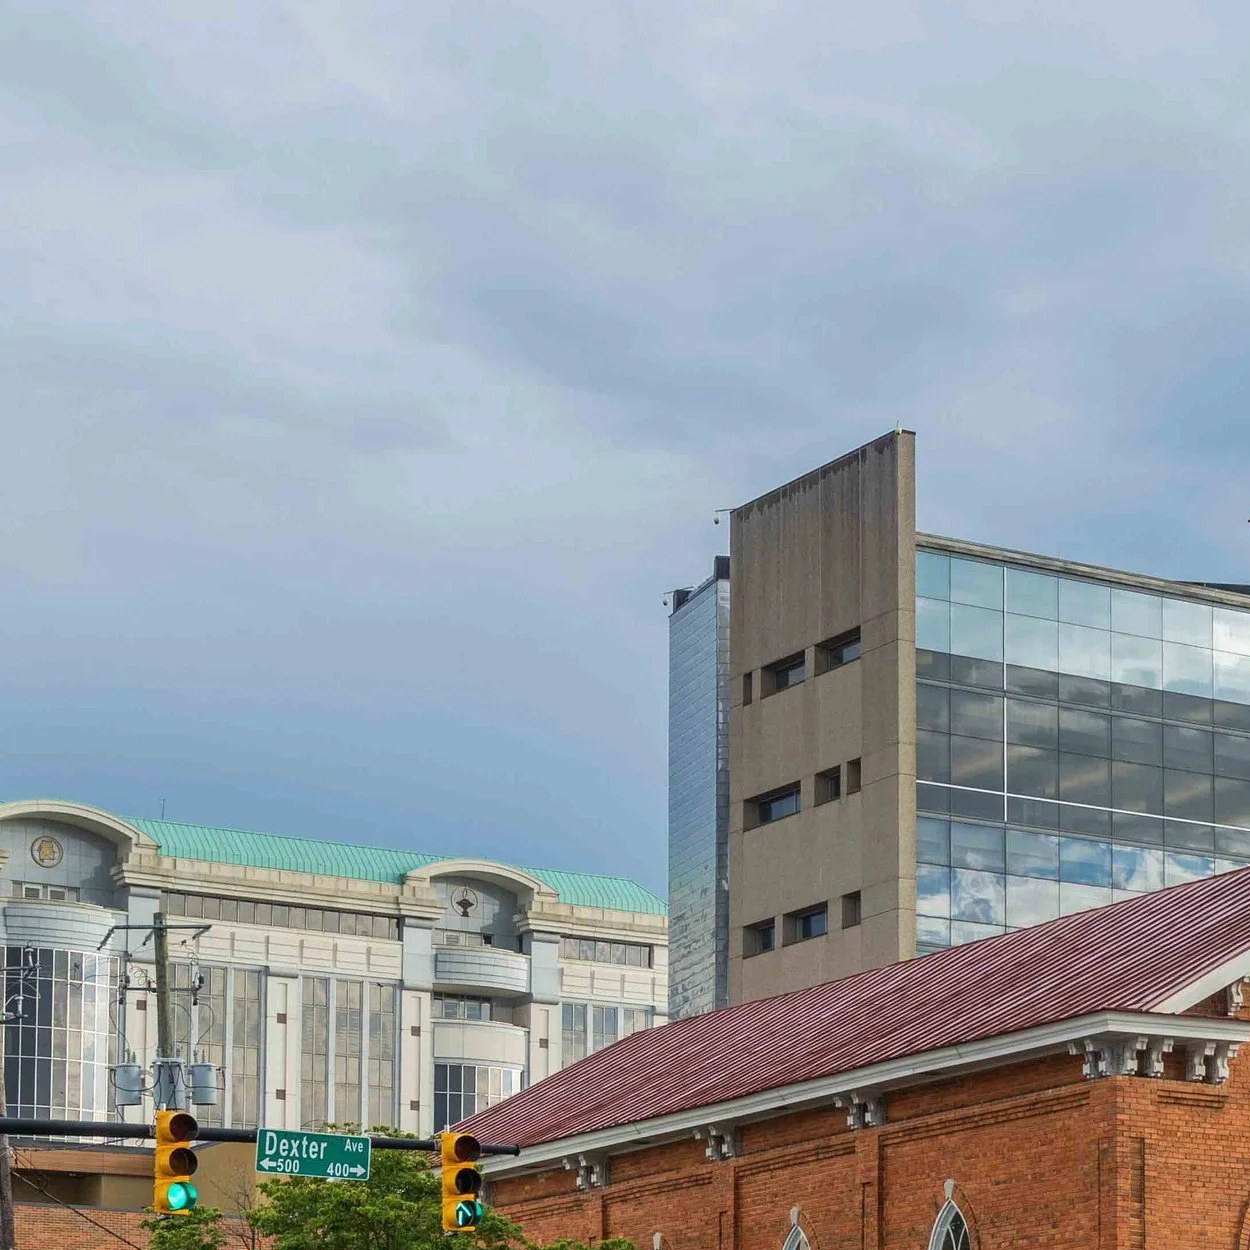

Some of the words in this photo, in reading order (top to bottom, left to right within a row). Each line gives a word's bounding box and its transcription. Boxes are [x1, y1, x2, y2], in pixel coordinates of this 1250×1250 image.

[265, 1131, 328, 1159] Dexter
[344, 1138, 364, 1153] Ave
[276, 1158, 300, 1173] 500
[326, 1162, 350, 1177] 400
